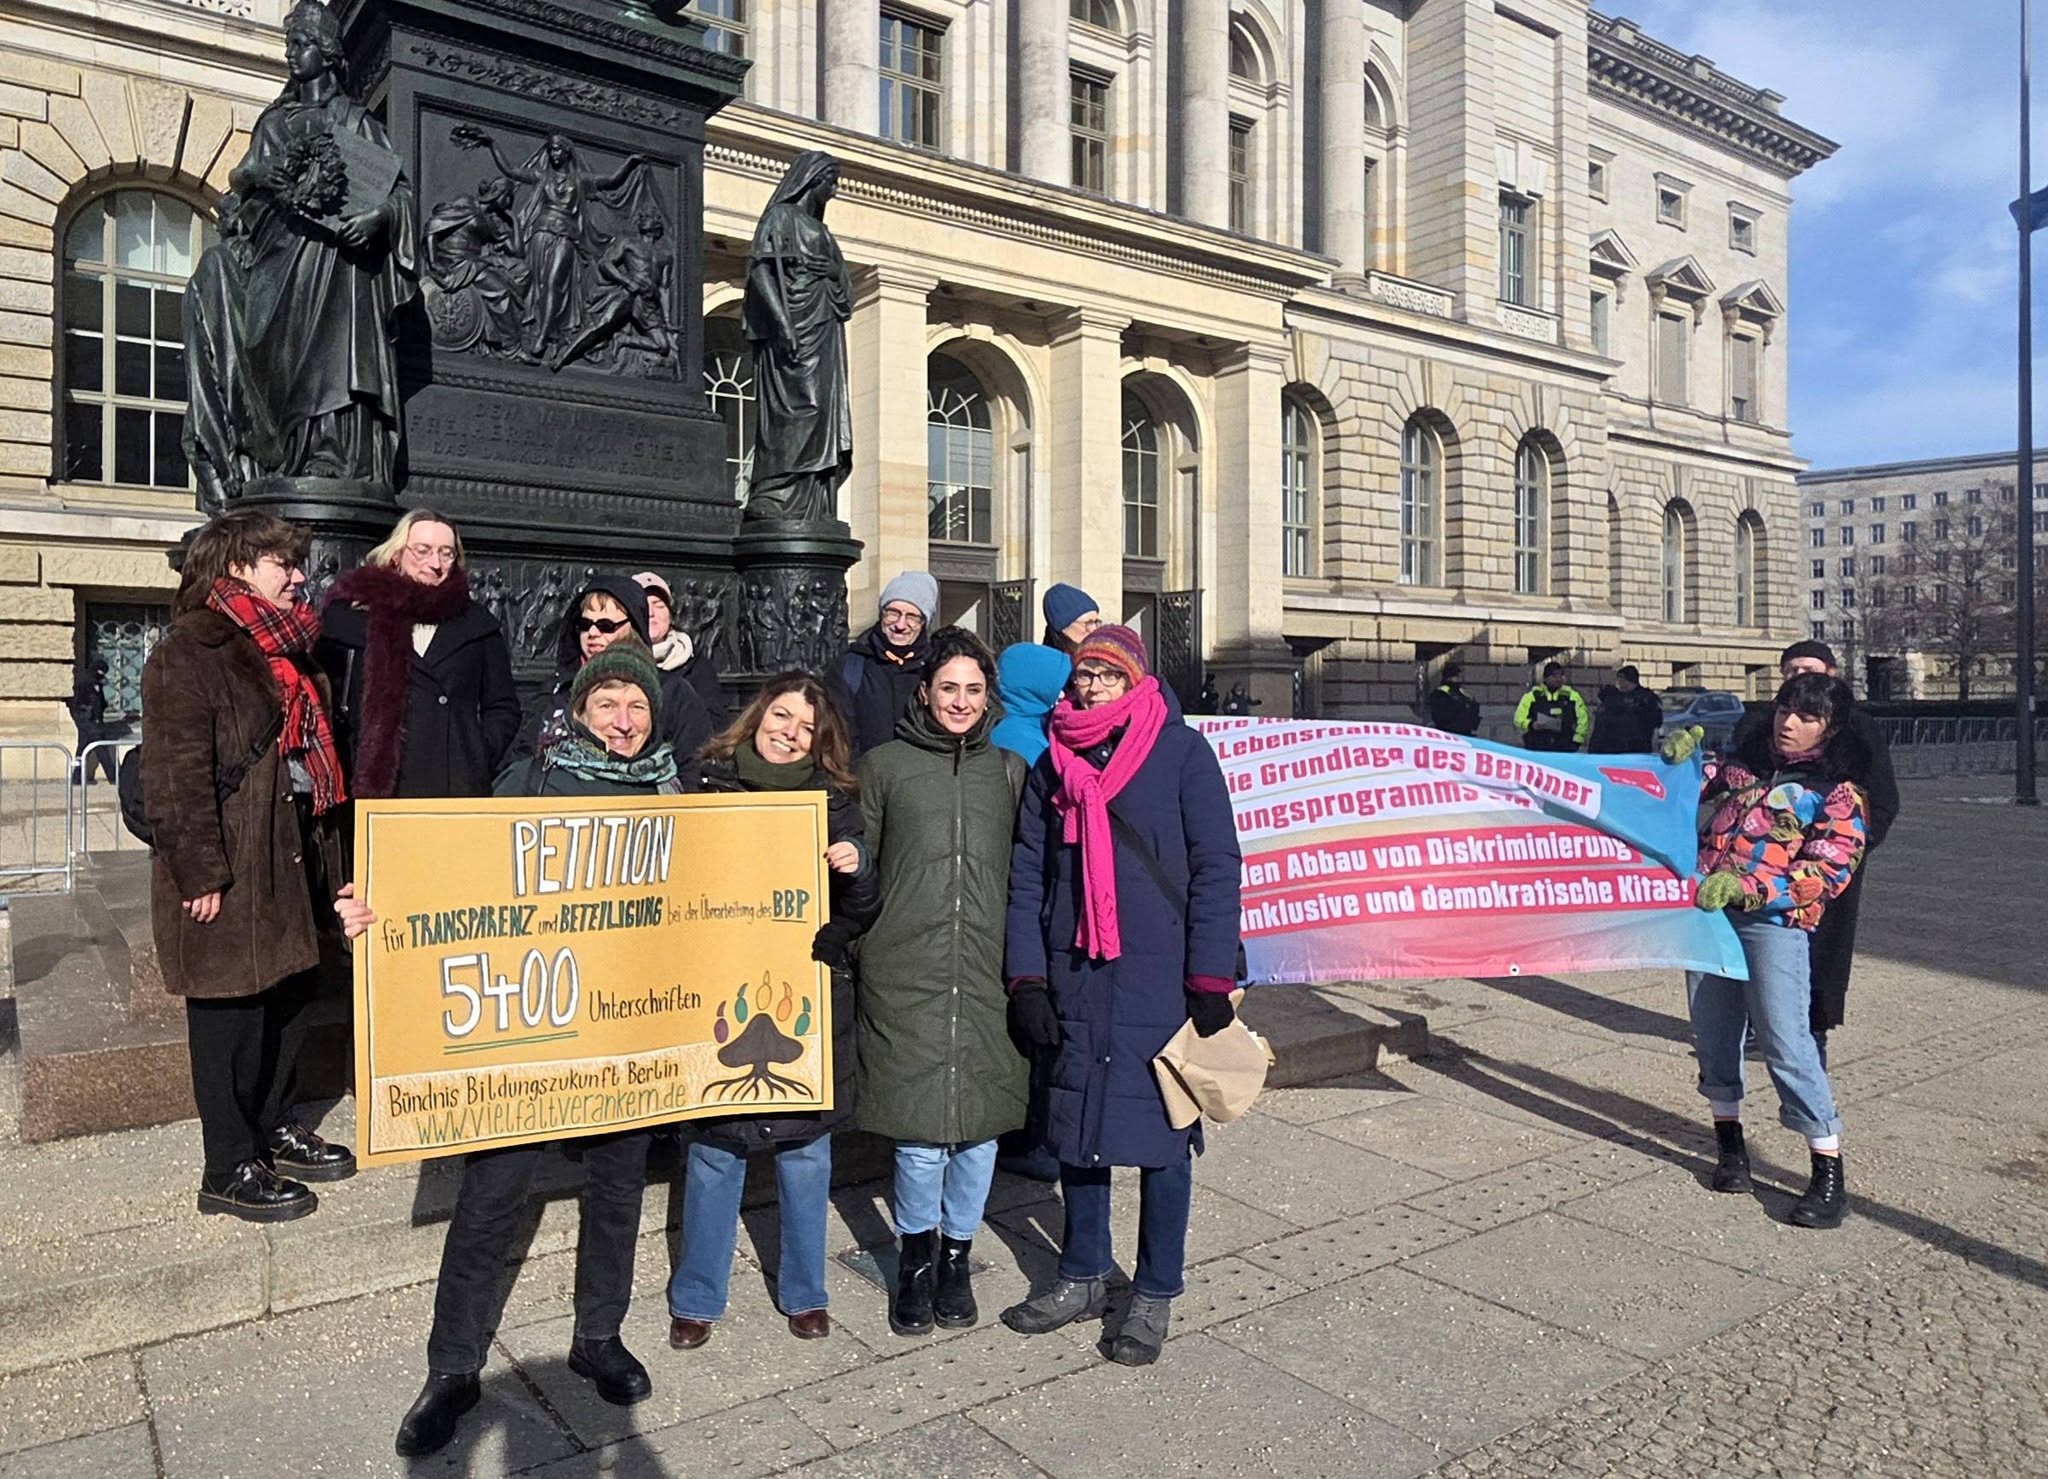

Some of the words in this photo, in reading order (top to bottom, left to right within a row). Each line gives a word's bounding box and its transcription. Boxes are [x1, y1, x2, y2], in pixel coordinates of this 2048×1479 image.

[1226, 772, 1253, 794] ie
[1414, 746, 1466, 773] des
[1475, 752, 1593, 806] Berliner
[1237, 780, 1479, 832] ungsprogramms
[511, 815, 676, 898] PETITION
[1287, 849, 1368, 881] Abbau
[1372, 843, 1422, 870] von
[1425, 832, 1633, 866] Diskriminierung
[382, 917, 405, 953] für
[406, 904, 538, 948] TRANSPARENZ
[538, 914, 558, 936] und
[559, 896, 664, 933] BETEILIGUNG
[667, 896, 682, 926] bei
[684, 900, 699, 921] der
[756, 901, 773, 922] des
[772, 888, 811, 919] BBP
[1240, 893, 1361, 933] inklusive
[1365, 885, 1416, 914] und
[1420, 876, 1614, 912] demokratische
[1617, 875, 1689, 904] Kitas!
[438, 946, 581, 1040] 5400
[588, 984, 702, 1023] Unterschriften
[388, 1081, 460, 1118] Bündnis
[467, 1065, 620, 1105] Bildungszukunft
[627, 1058, 679, 1086] Berlin
